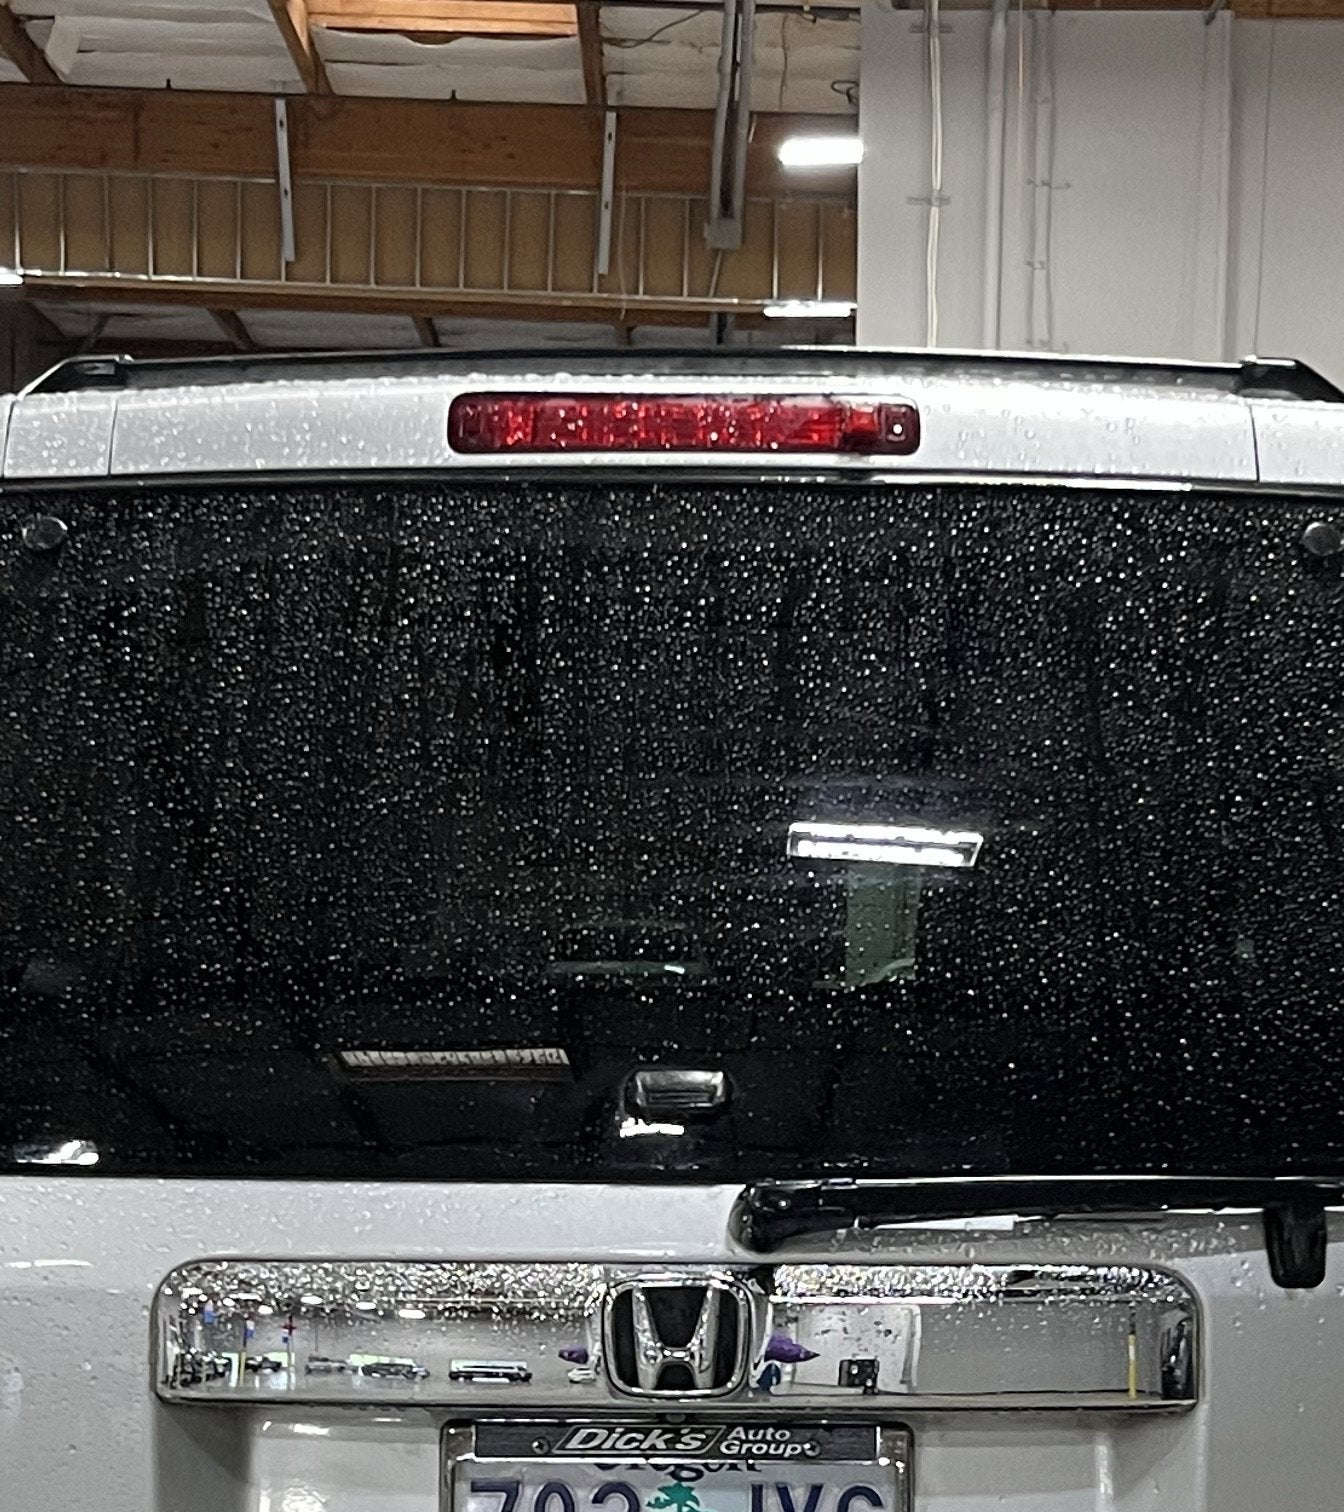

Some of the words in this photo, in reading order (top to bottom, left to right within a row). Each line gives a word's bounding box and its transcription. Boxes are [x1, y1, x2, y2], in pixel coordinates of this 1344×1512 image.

[565, 1427, 707, 1450] Dick's
[726, 1426, 791, 1442] Auto
[719, 1440, 808, 1458] Group
